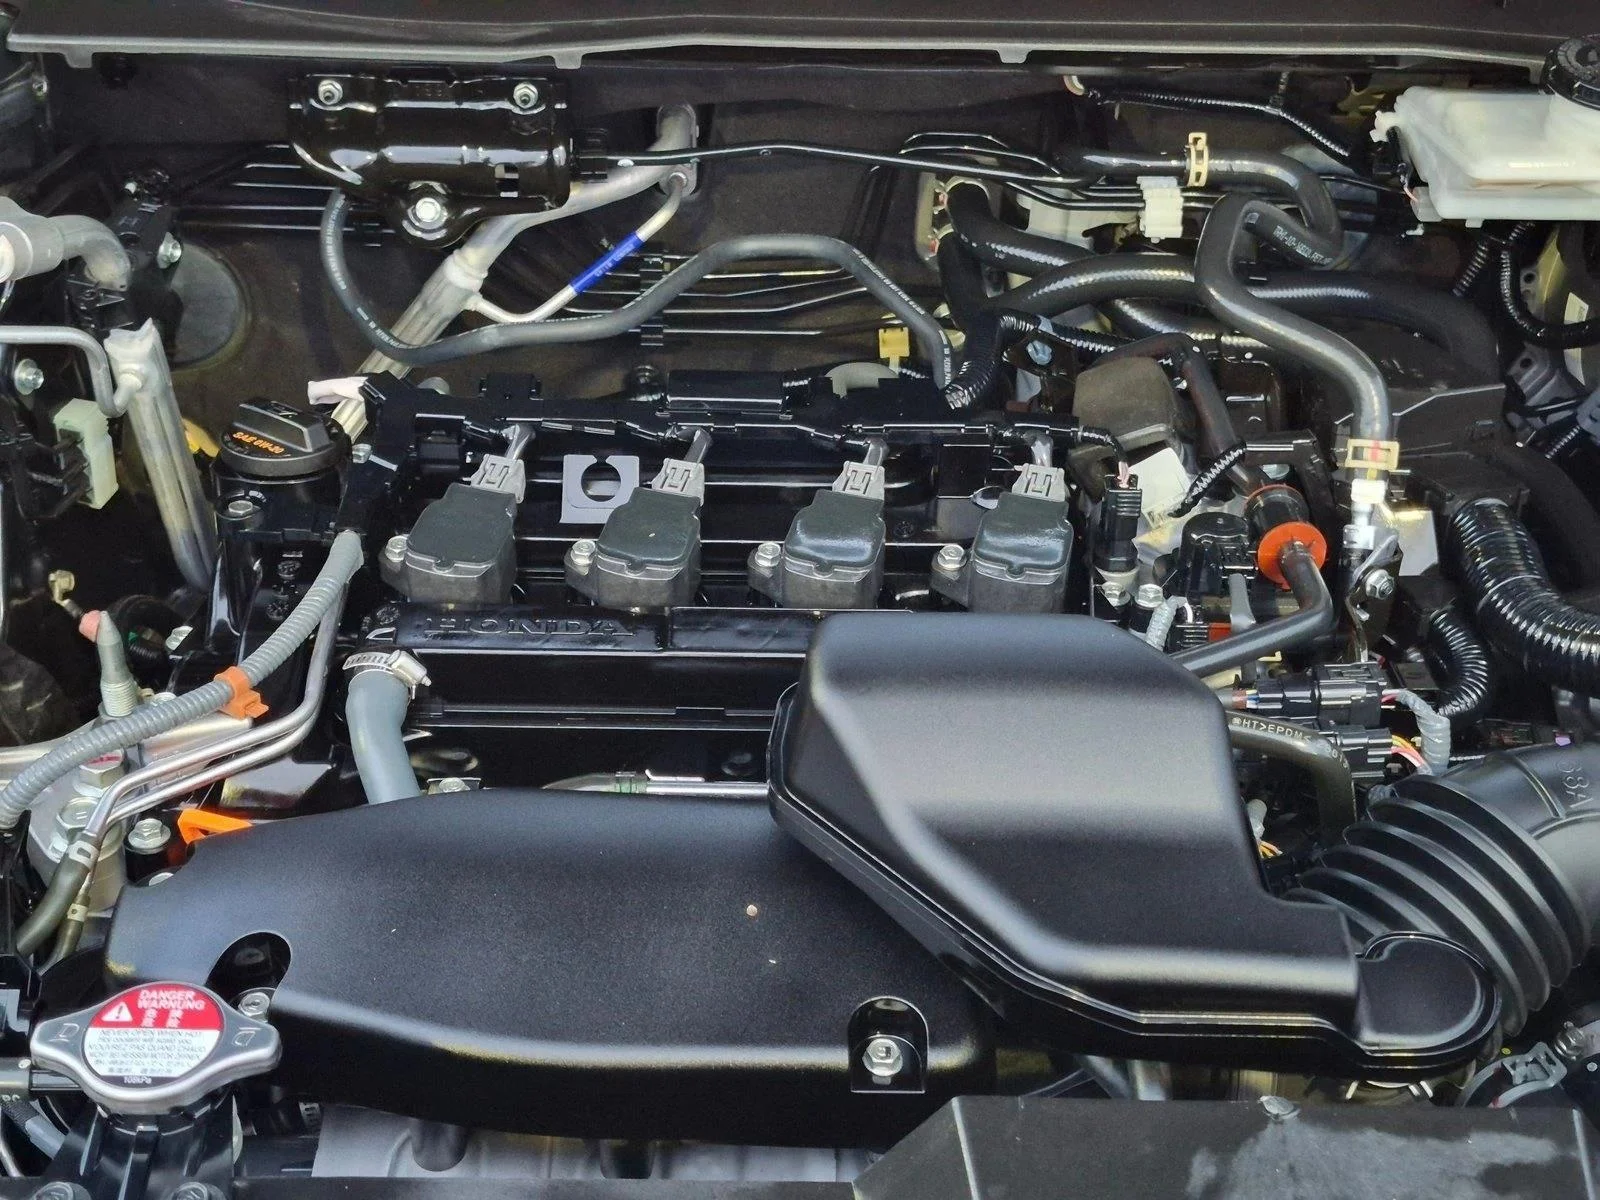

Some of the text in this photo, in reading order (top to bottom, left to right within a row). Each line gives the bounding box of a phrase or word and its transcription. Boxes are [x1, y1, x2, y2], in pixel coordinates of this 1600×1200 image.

[232, 431, 258, 443] SAE
[423, 617, 635, 636] HONDA
[139, 989, 196, 1001] DANGER
[137, 999, 206, 1010] WARNUNG
